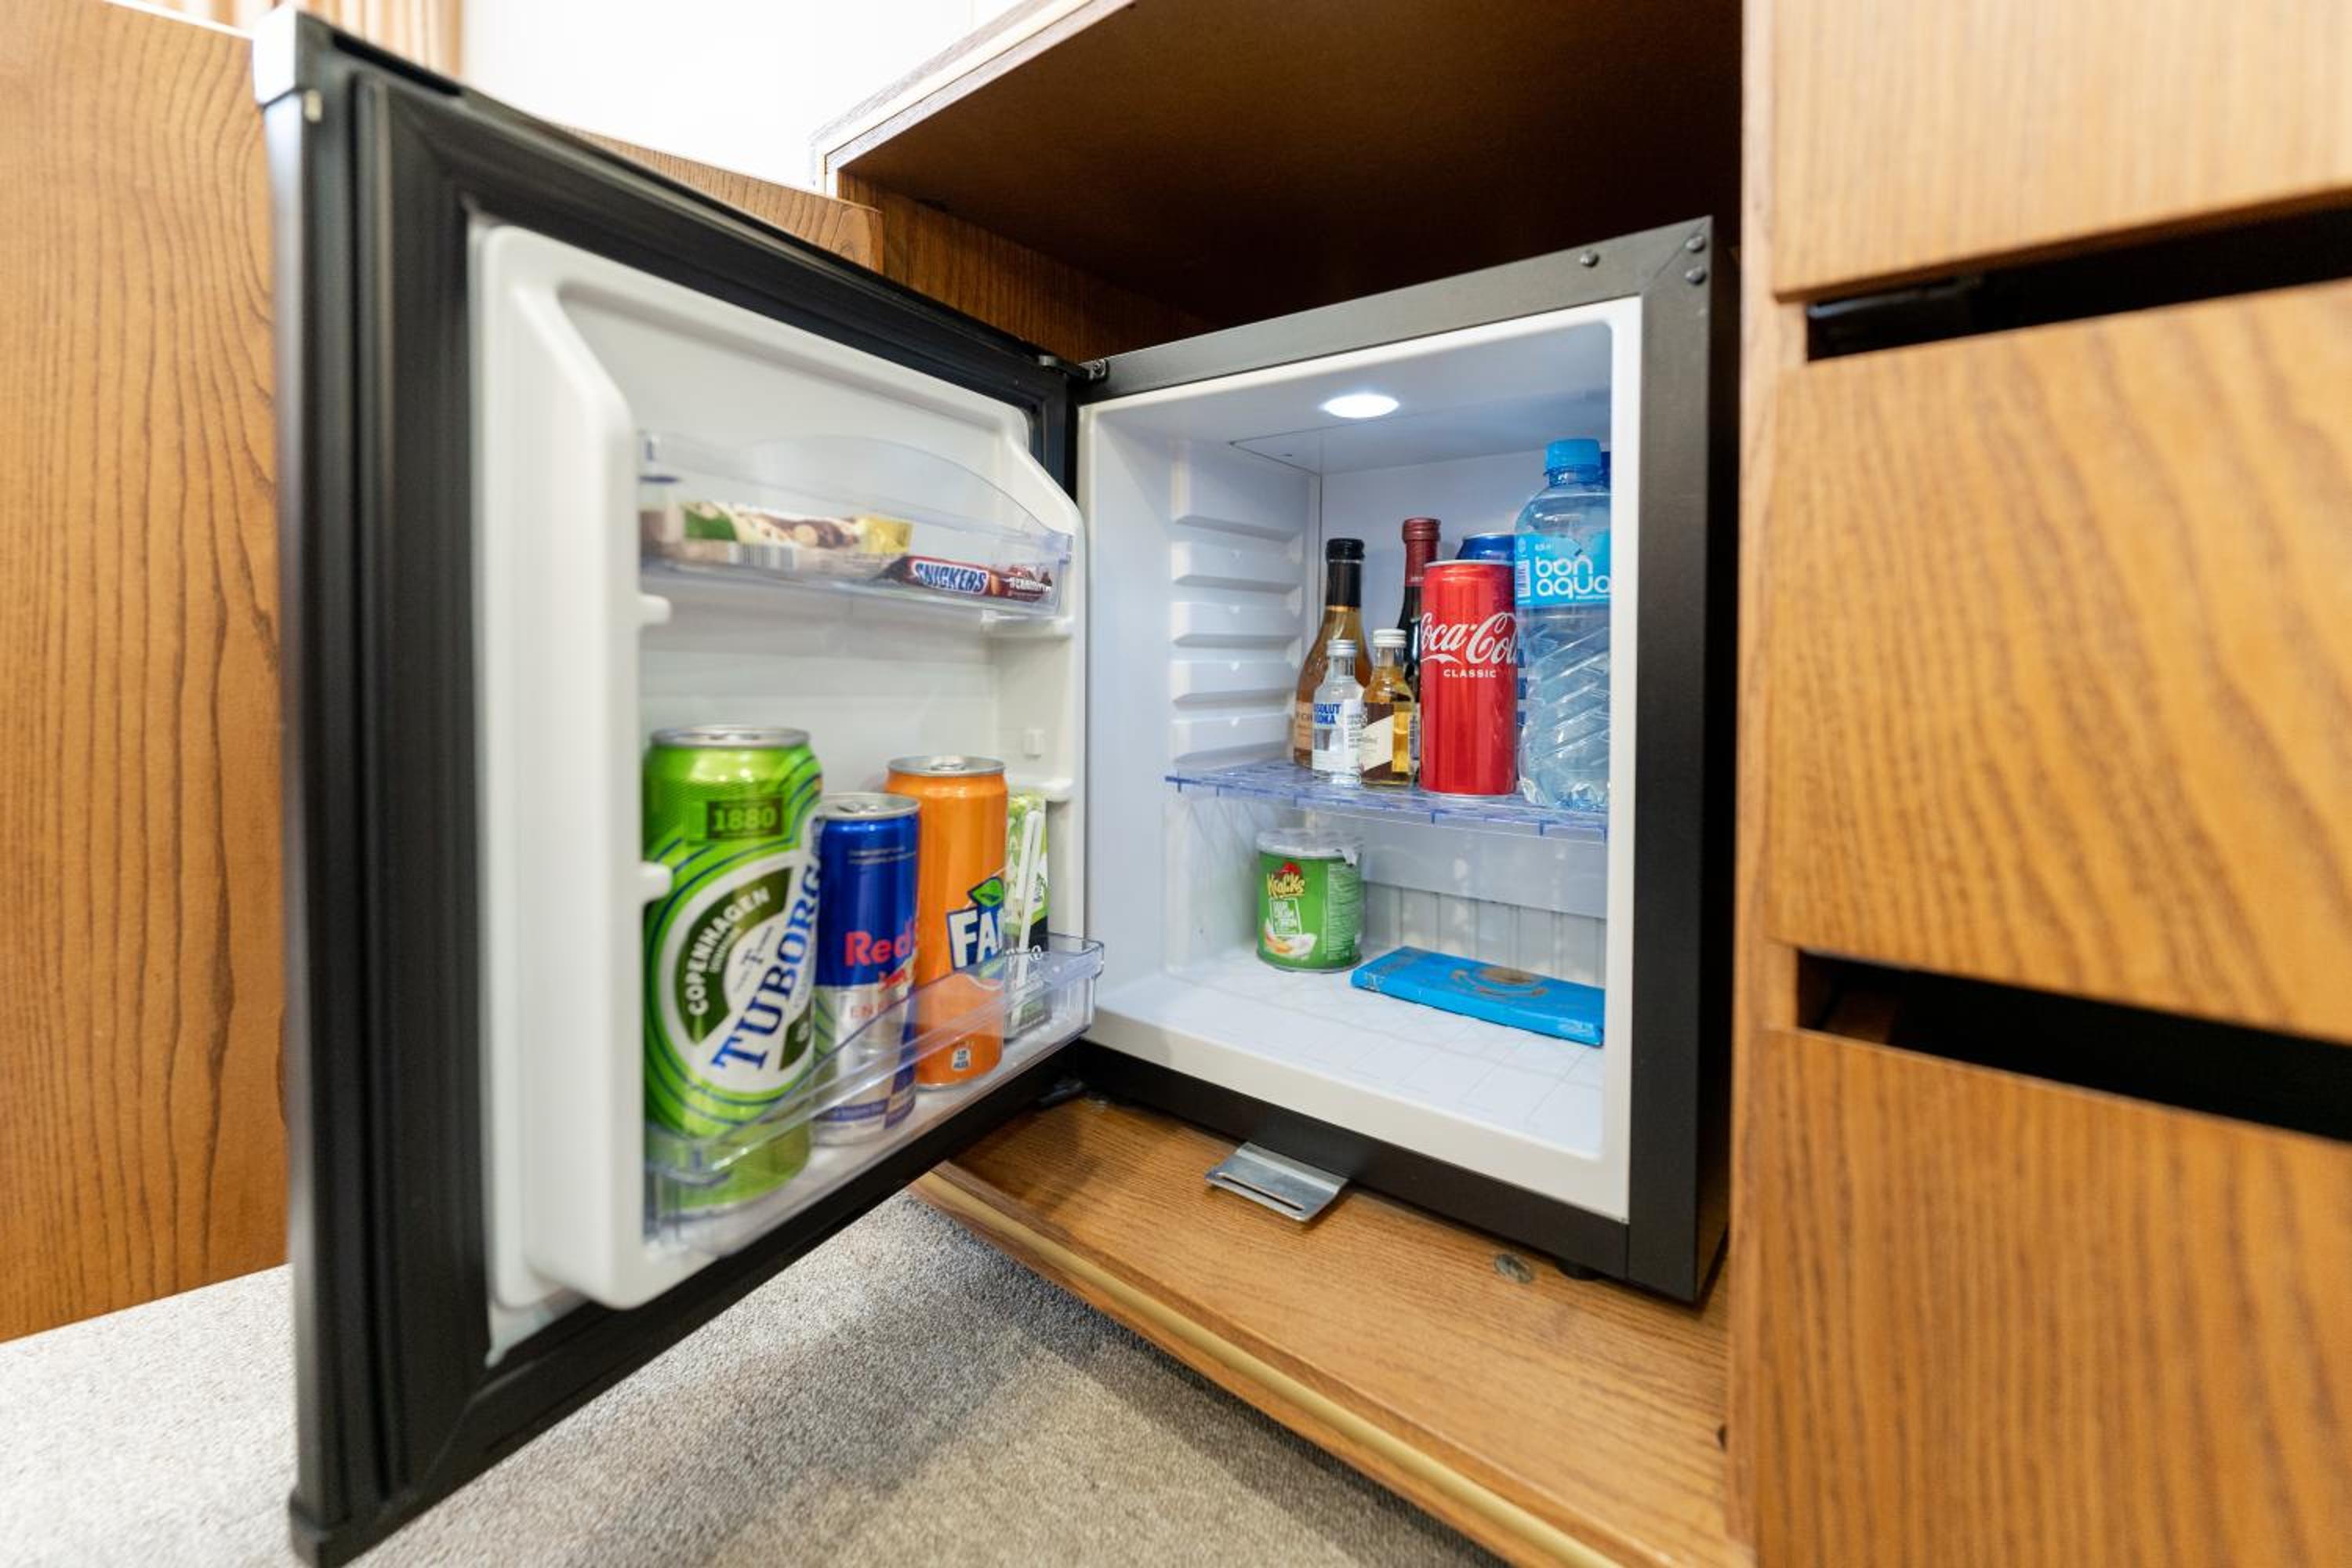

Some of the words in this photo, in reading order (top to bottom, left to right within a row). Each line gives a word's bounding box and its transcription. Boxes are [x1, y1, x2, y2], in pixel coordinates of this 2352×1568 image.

[915, 563, 986, 593] SNICKERS
[1535, 554, 1593, 578] bon
[1421, 612, 1518, 665] Coca-Col
[1443, 669, 1497, 678] CLASSIC
[714, 806, 778, 831] 1880
[684, 887, 771, 1016] COPENHAGEN
[845, 916, 913, 967] Red
[710, 863, 821, 1070] TUBORG
